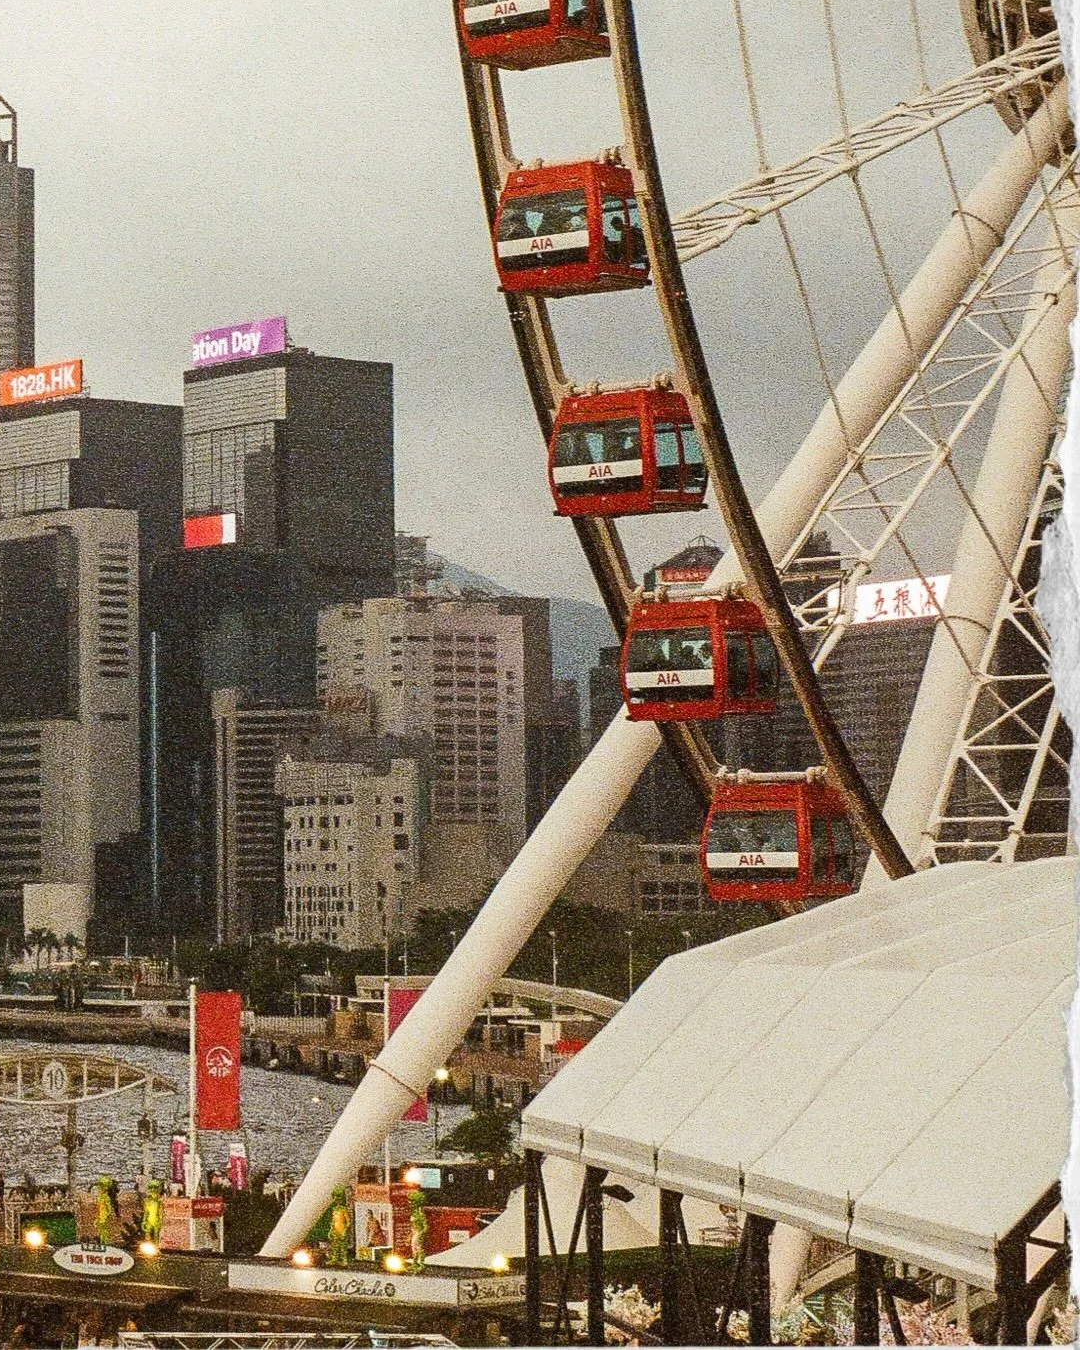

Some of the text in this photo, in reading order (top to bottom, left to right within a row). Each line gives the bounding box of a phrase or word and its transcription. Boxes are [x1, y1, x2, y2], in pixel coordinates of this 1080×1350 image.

[494, 1, 518, 17] AIA
[530, 237, 554, 252] AIA
[231, 330, 262, 356] Day
[10, 364, 76, 399] 1828.HK
[588, 464, 614, 479] AIA
[656, 672, 682, 686] AIA
[738, 854, 766, 867] AIA
[46, 1067, 64, 1091] 10
